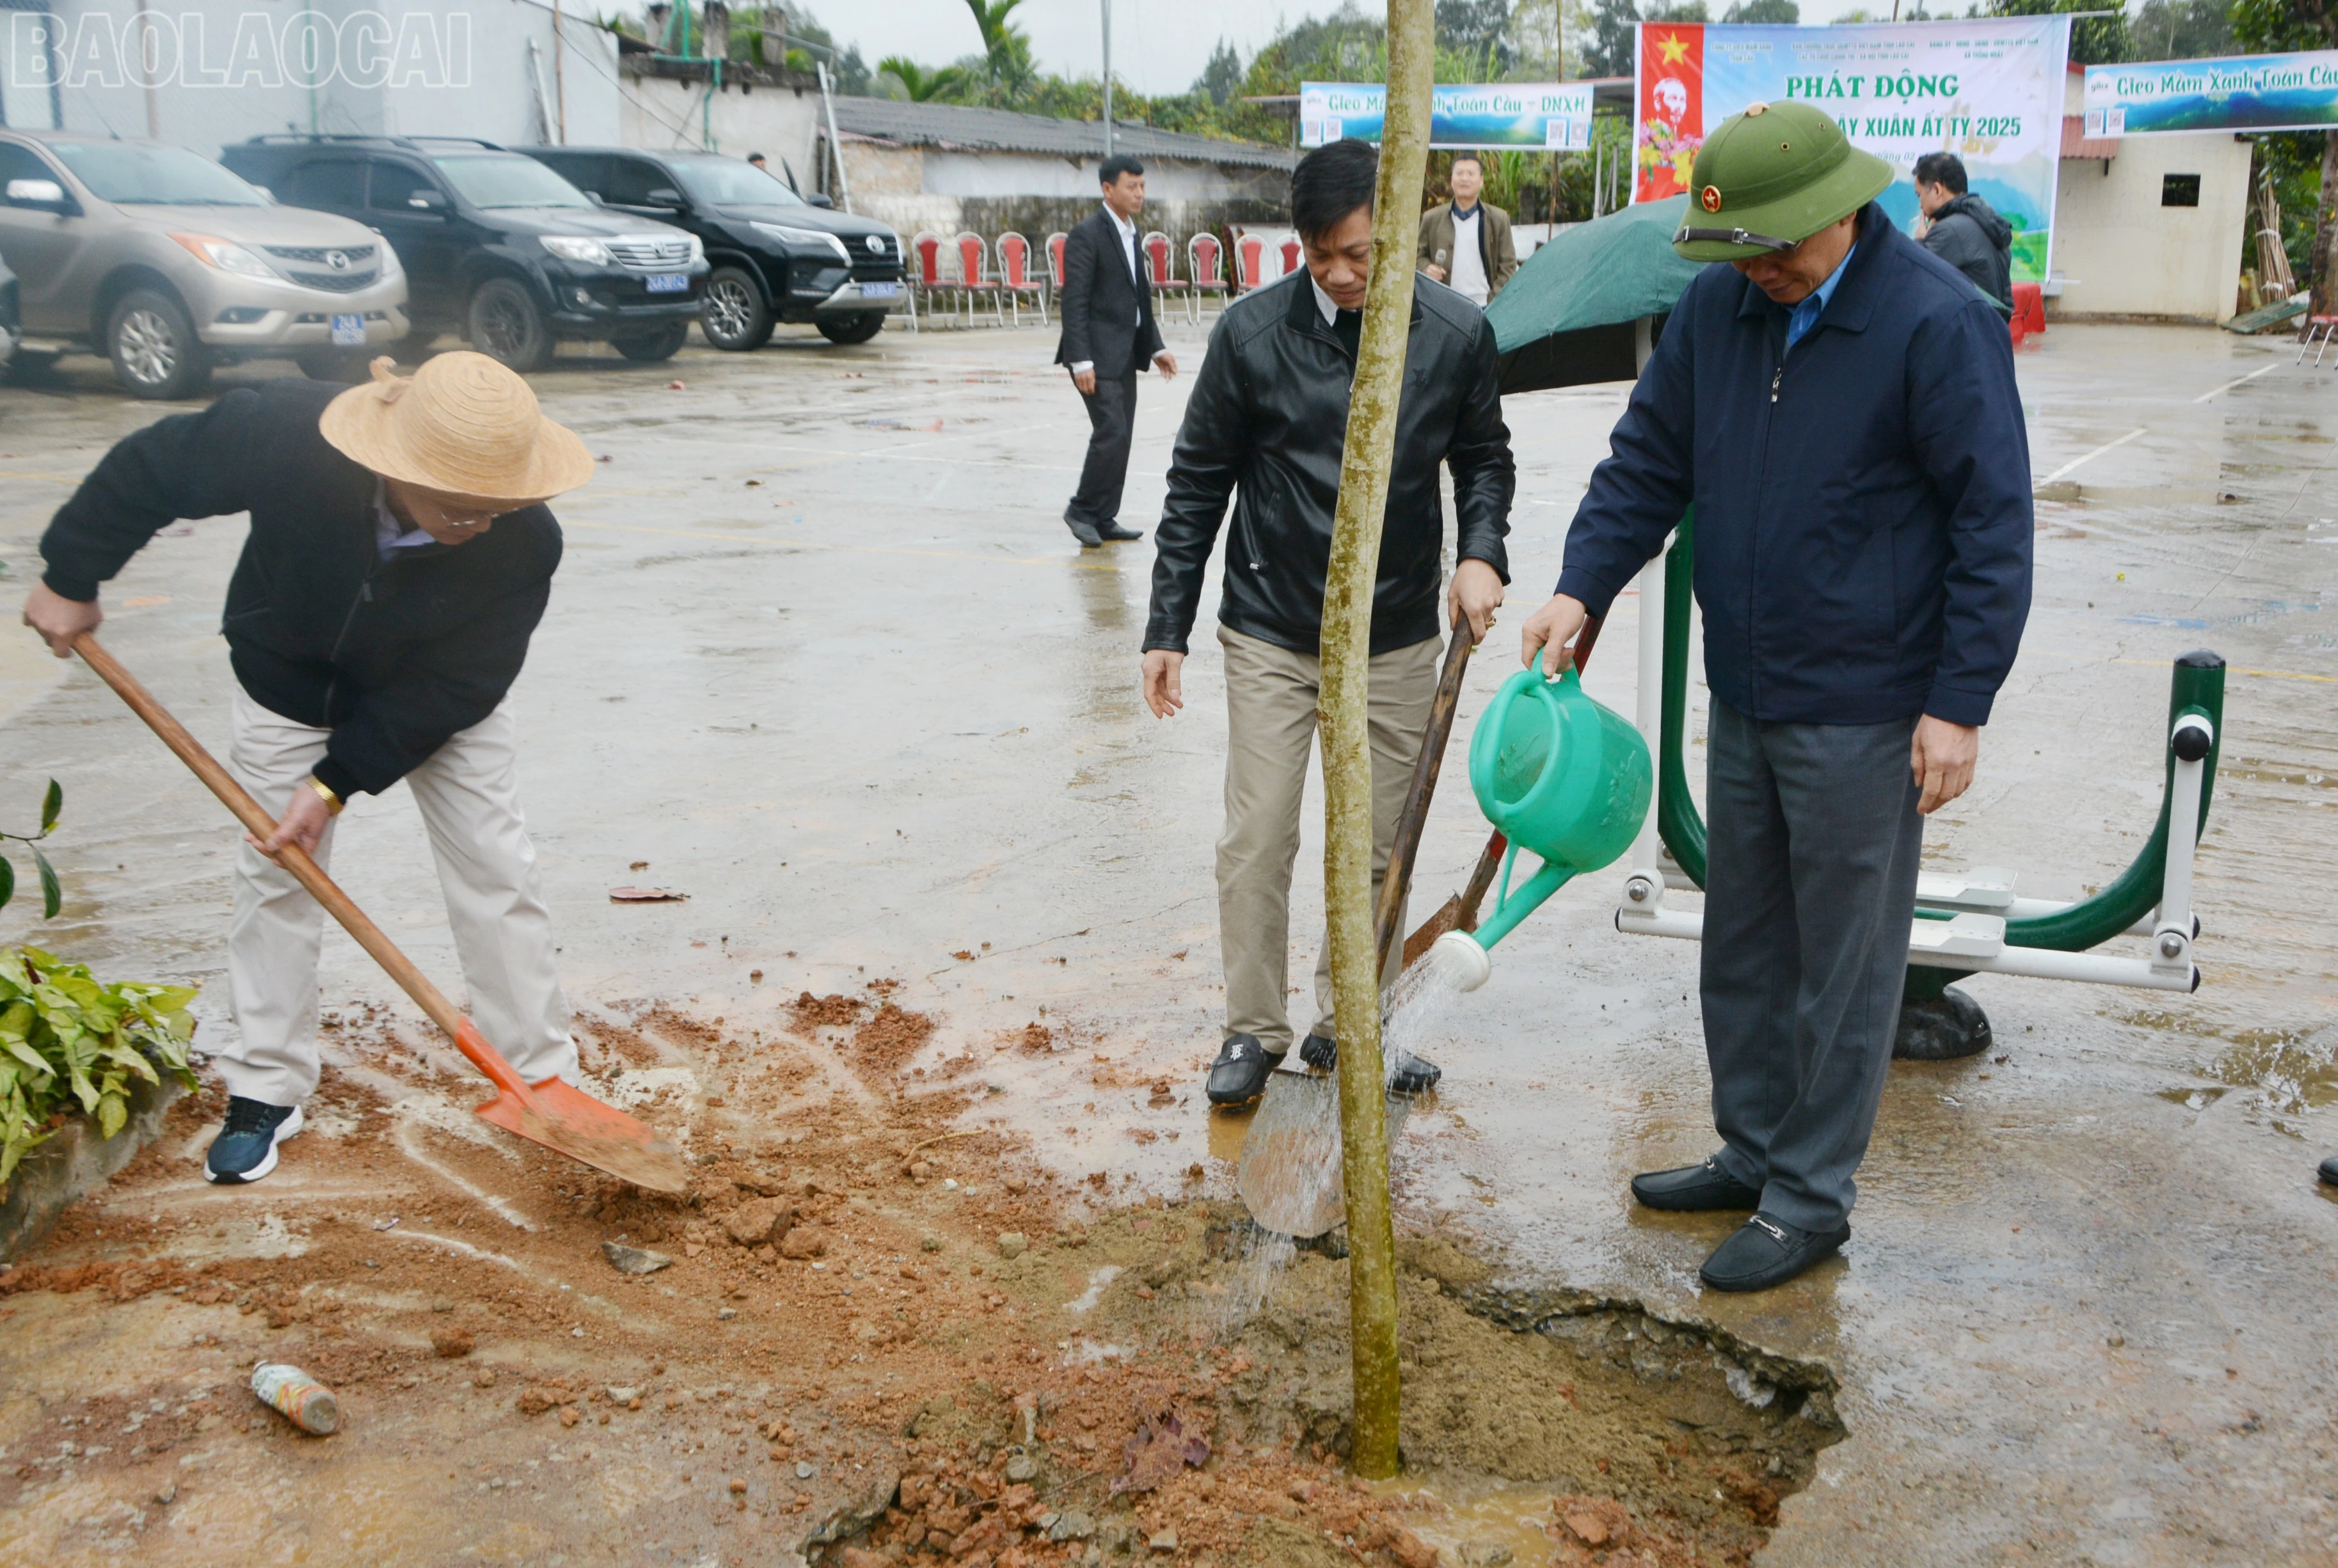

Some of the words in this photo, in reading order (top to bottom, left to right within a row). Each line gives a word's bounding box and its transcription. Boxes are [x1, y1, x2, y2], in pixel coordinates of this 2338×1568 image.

[1786, 69, 1865, 98] PHÁT
[1874, 68, 1959, 104] ĐỘNG
[2117, 76, 2154, 97] Gieo
[2161, 69, 2202, 95] Mầm
[2209, 68, 2254, 91] Xanh
[2260, 68, 2303, 88] Toàn
[1328, 94, 1361, 111] Gieo
[1451, 94, 1488, 111] Toàn
[1493, 92, 1522, 112] Cầu
[1541, 96, 1585, 113] DNXH
[1838, 113, 1858, 136] ÂY
[1865, 113, 1915, 137] XUÂN
[1921, 109, 1945, 137] ẤT
[1950, 117, 1971, 142] TỴ
[1977, 116, 2021, 137] 2025
